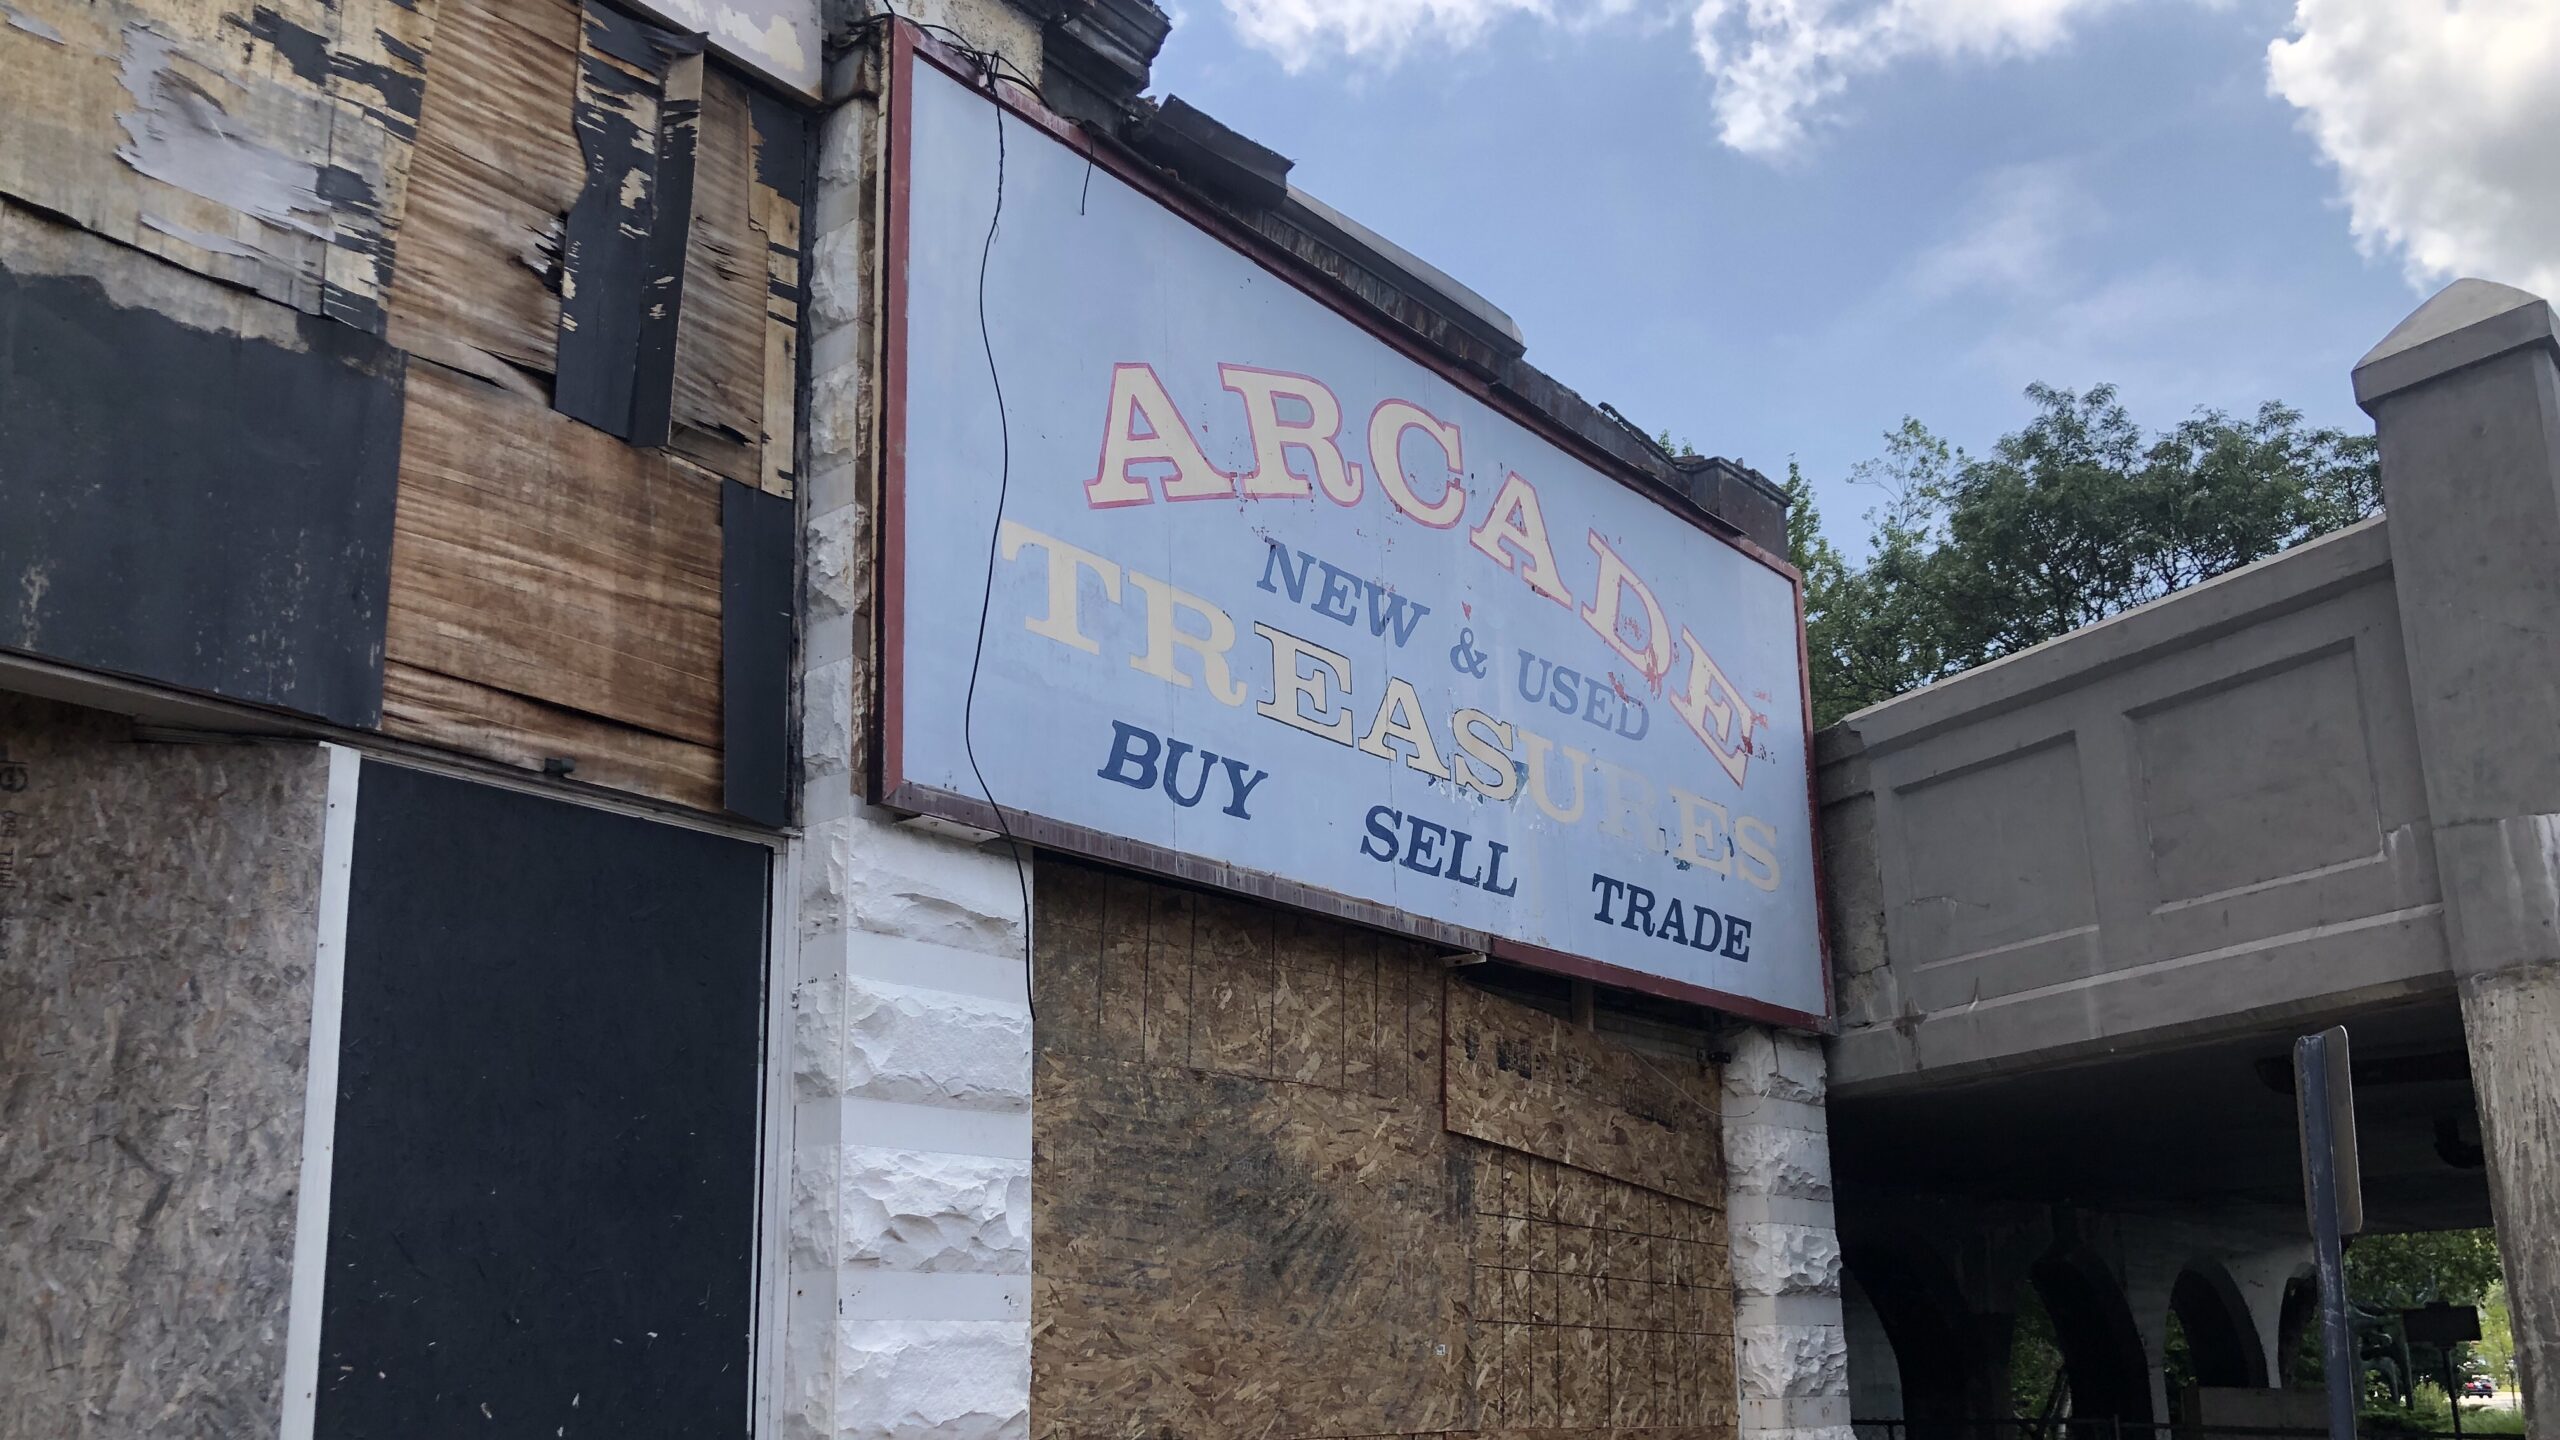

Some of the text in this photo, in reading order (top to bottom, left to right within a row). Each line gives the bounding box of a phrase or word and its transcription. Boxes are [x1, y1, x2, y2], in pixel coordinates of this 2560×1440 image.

[998, 518, 1781, 892] TREASURES
[1083, 362, 1757, 789] ARCADE
[1257, 539, 1650, 742] NEW & USED
[1097, 720, 1752, 962] BUY SELL TRADE
